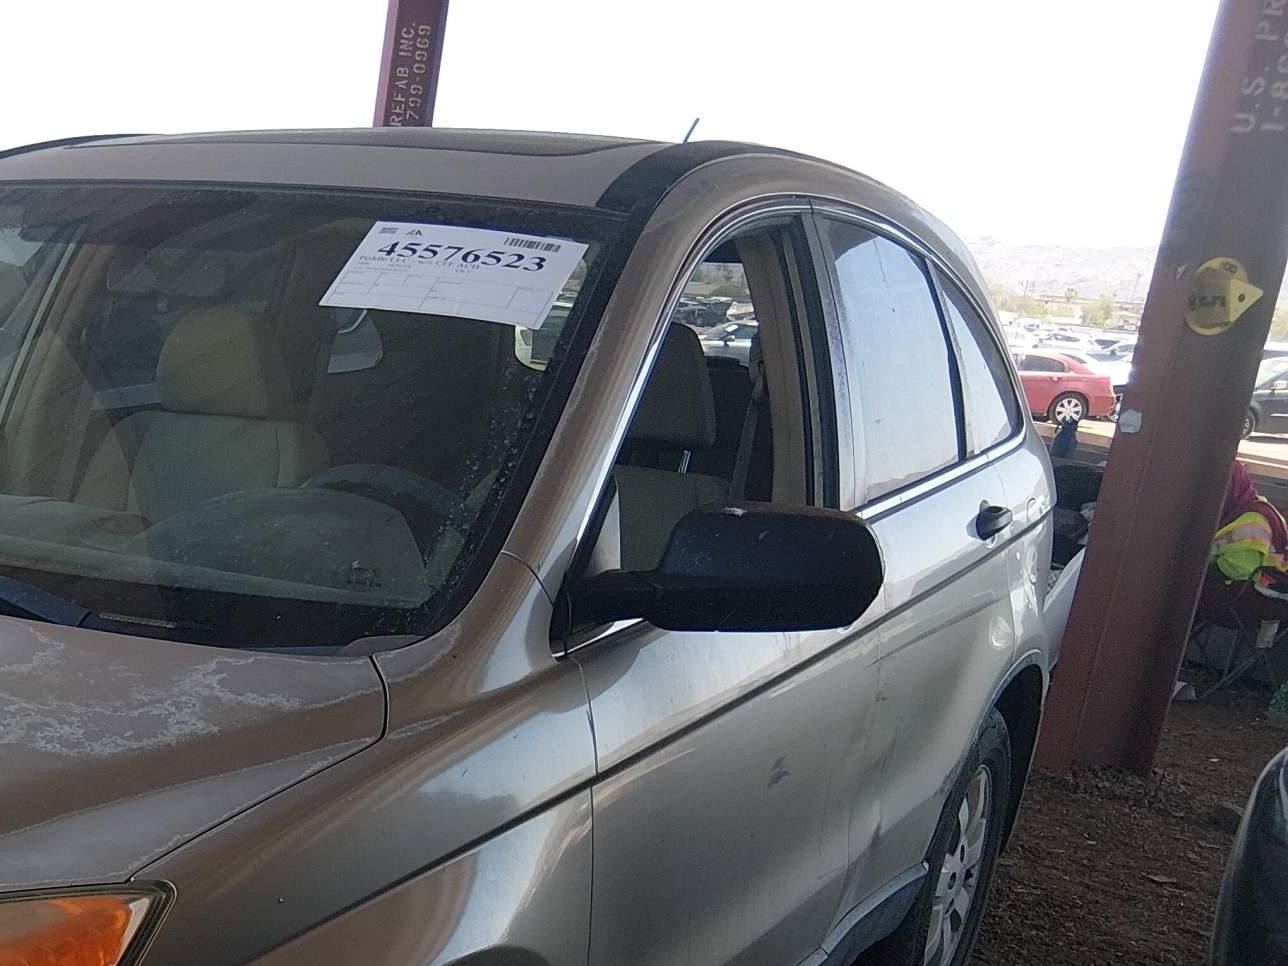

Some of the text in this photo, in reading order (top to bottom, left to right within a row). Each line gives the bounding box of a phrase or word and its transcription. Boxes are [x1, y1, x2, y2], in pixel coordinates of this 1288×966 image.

[398, 22, 416, 57] INC.
[406, 24, 431, 120] 799-0969
[377, 240, 547, 272] 45576523
